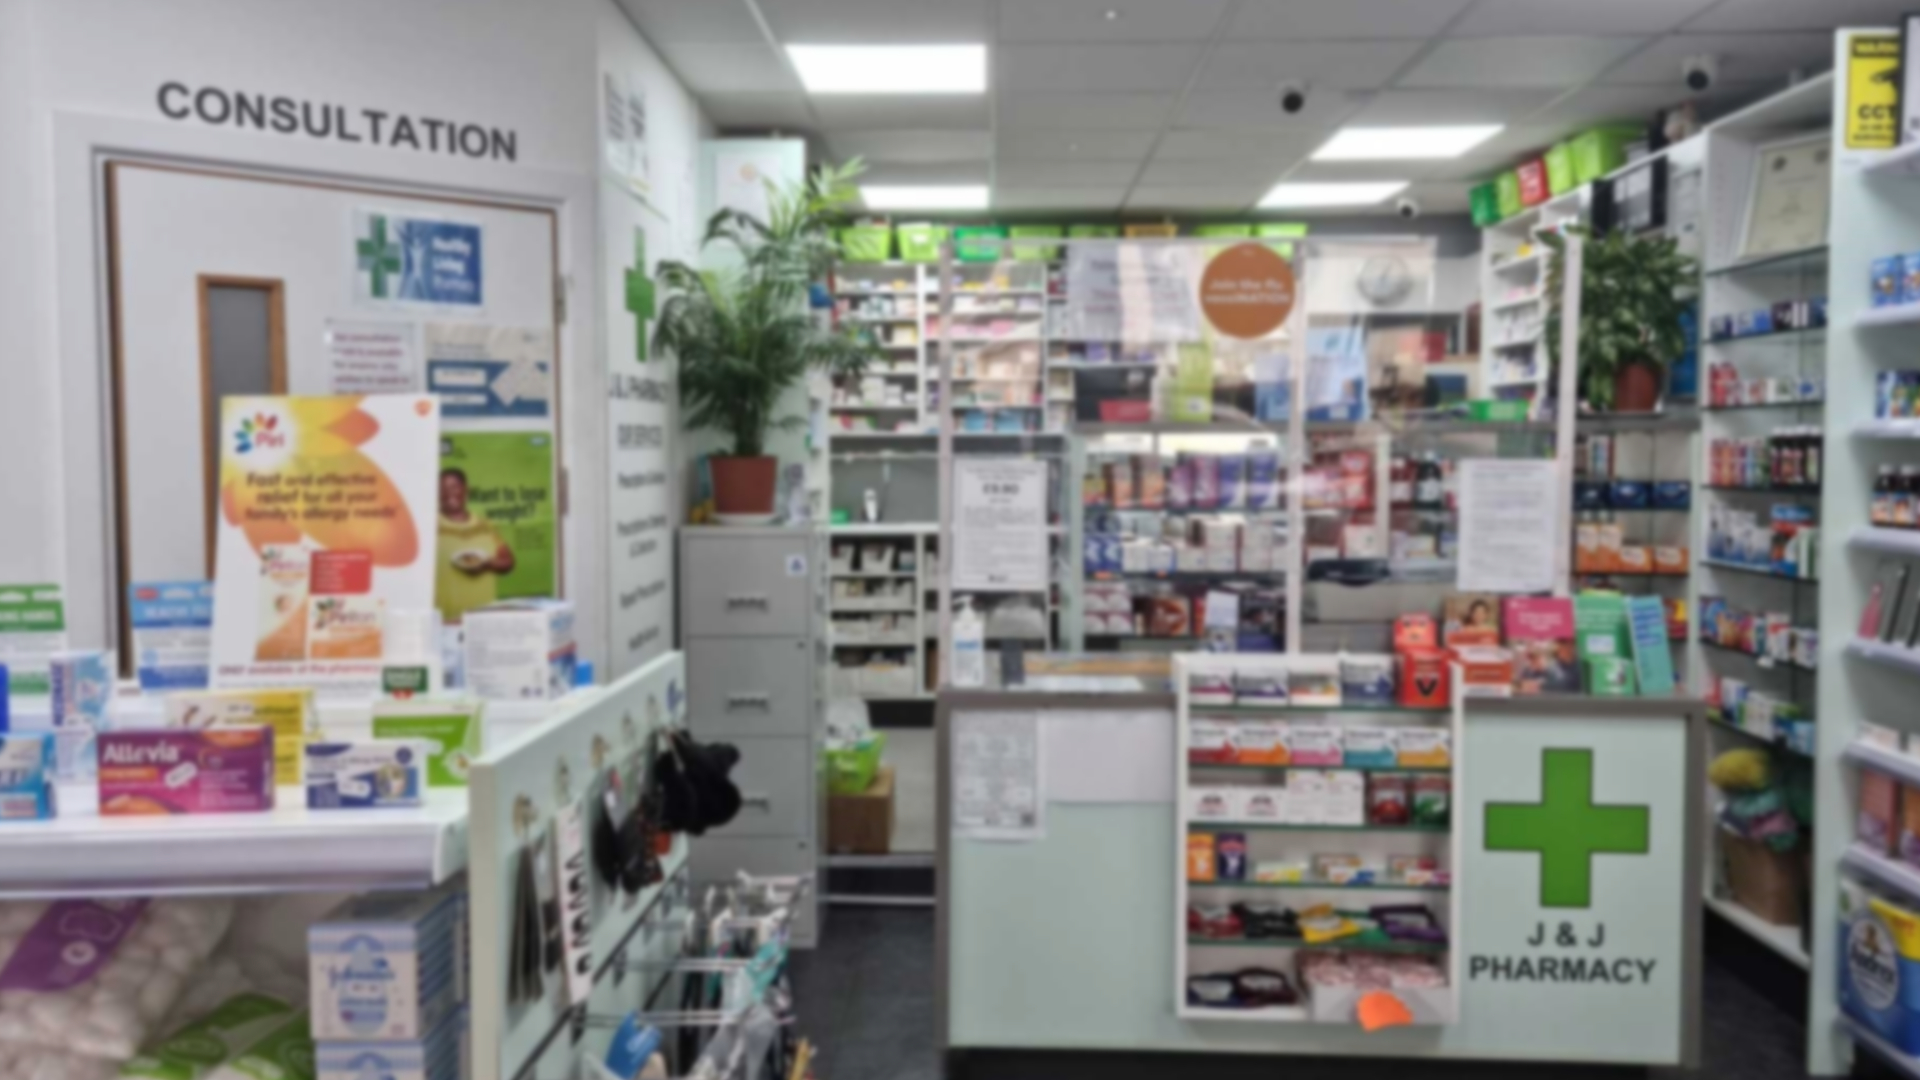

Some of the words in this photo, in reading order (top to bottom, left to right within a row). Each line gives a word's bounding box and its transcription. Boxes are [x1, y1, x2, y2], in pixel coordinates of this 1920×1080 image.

[157, 81, 517, 163] CONSULTATION
[432, 236, 471, 257] Healthy
[432, 254, 464, 276] Living
[1208, 278, 1237, 291] Join
[1240, 279, 1261, 290] the
[1264, 279, 1283, 289] flu
[256, 430, 285, 448] Piri
[247, 473, 281, 487] Fast
[285, 473, 312, 487] and
[316, 473, 377, 487] effective
[256, 490, 298, 504] relief
[302, 490, 322, 504] for
[325, 491, 343, 503] all
[347, 493, 377, 505] your
[467, 485, 500, 503] Want
[502, 485, 516, 502] to
[518, 484, 547, 502] lose
[246, 507, 298, 522] family's
[302, 507, 349, 522] allergy
[485, 502, 535, 524] weight?
[217, 664, 246, 675] ONLY
[248, 664, 293, 674] available
[310, 663, 326, 673] the
[329, 662, 380, 675] pharmacy
[102, 739, 179, 764] Allevia
[1526, 921, 1545, 947] J
[1555, 921, 1577, 947] &
[1586, 923, 1605, 948] J
[1468, 954, 1658, 985] PHARMACY
